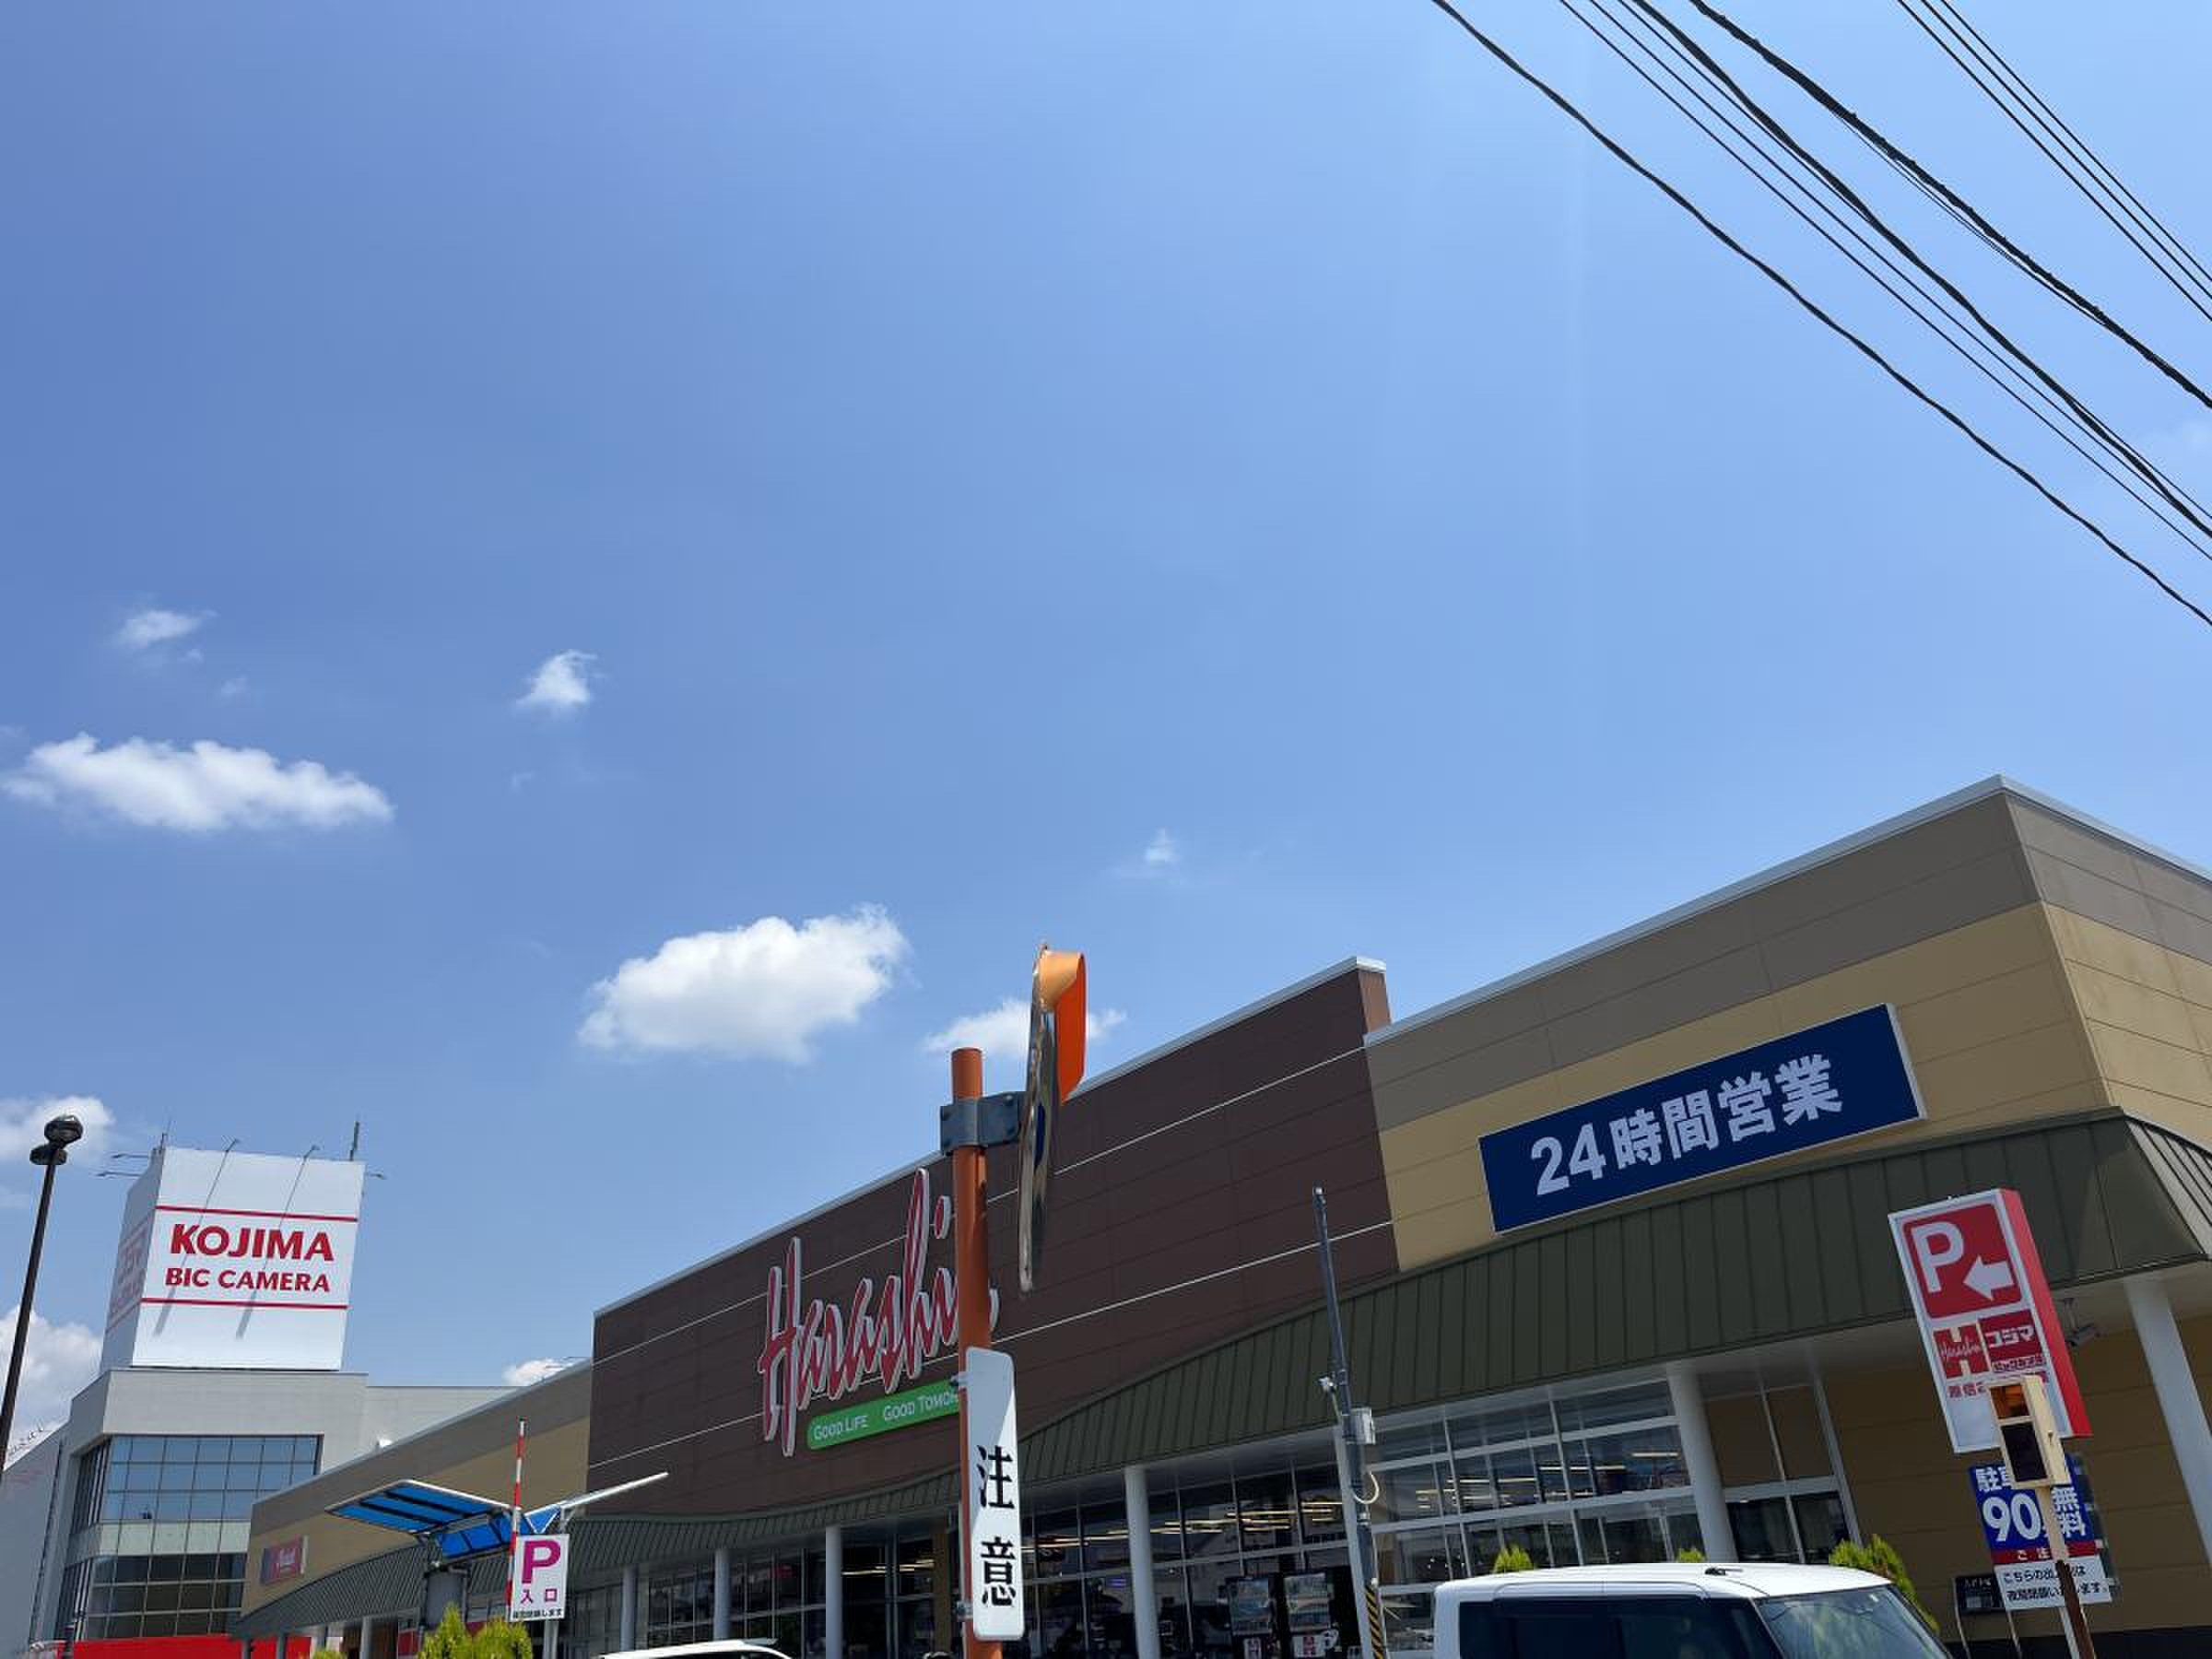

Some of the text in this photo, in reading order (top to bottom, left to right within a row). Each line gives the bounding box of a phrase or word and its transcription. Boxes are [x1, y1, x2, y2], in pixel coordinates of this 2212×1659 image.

[1531, 1053, 1842, 1195] 24時間営業
[170, 1223, 334, 1262] KOJIMA
[1911, 1220, 1964, 1294] P
[165, 1267, 330, 1292] BIC CAMERA
[976, 1444, 1016, 1606] 注意
[522, 1540, 561, 1583] P
[521, 1588, 558, 1604] 入口
